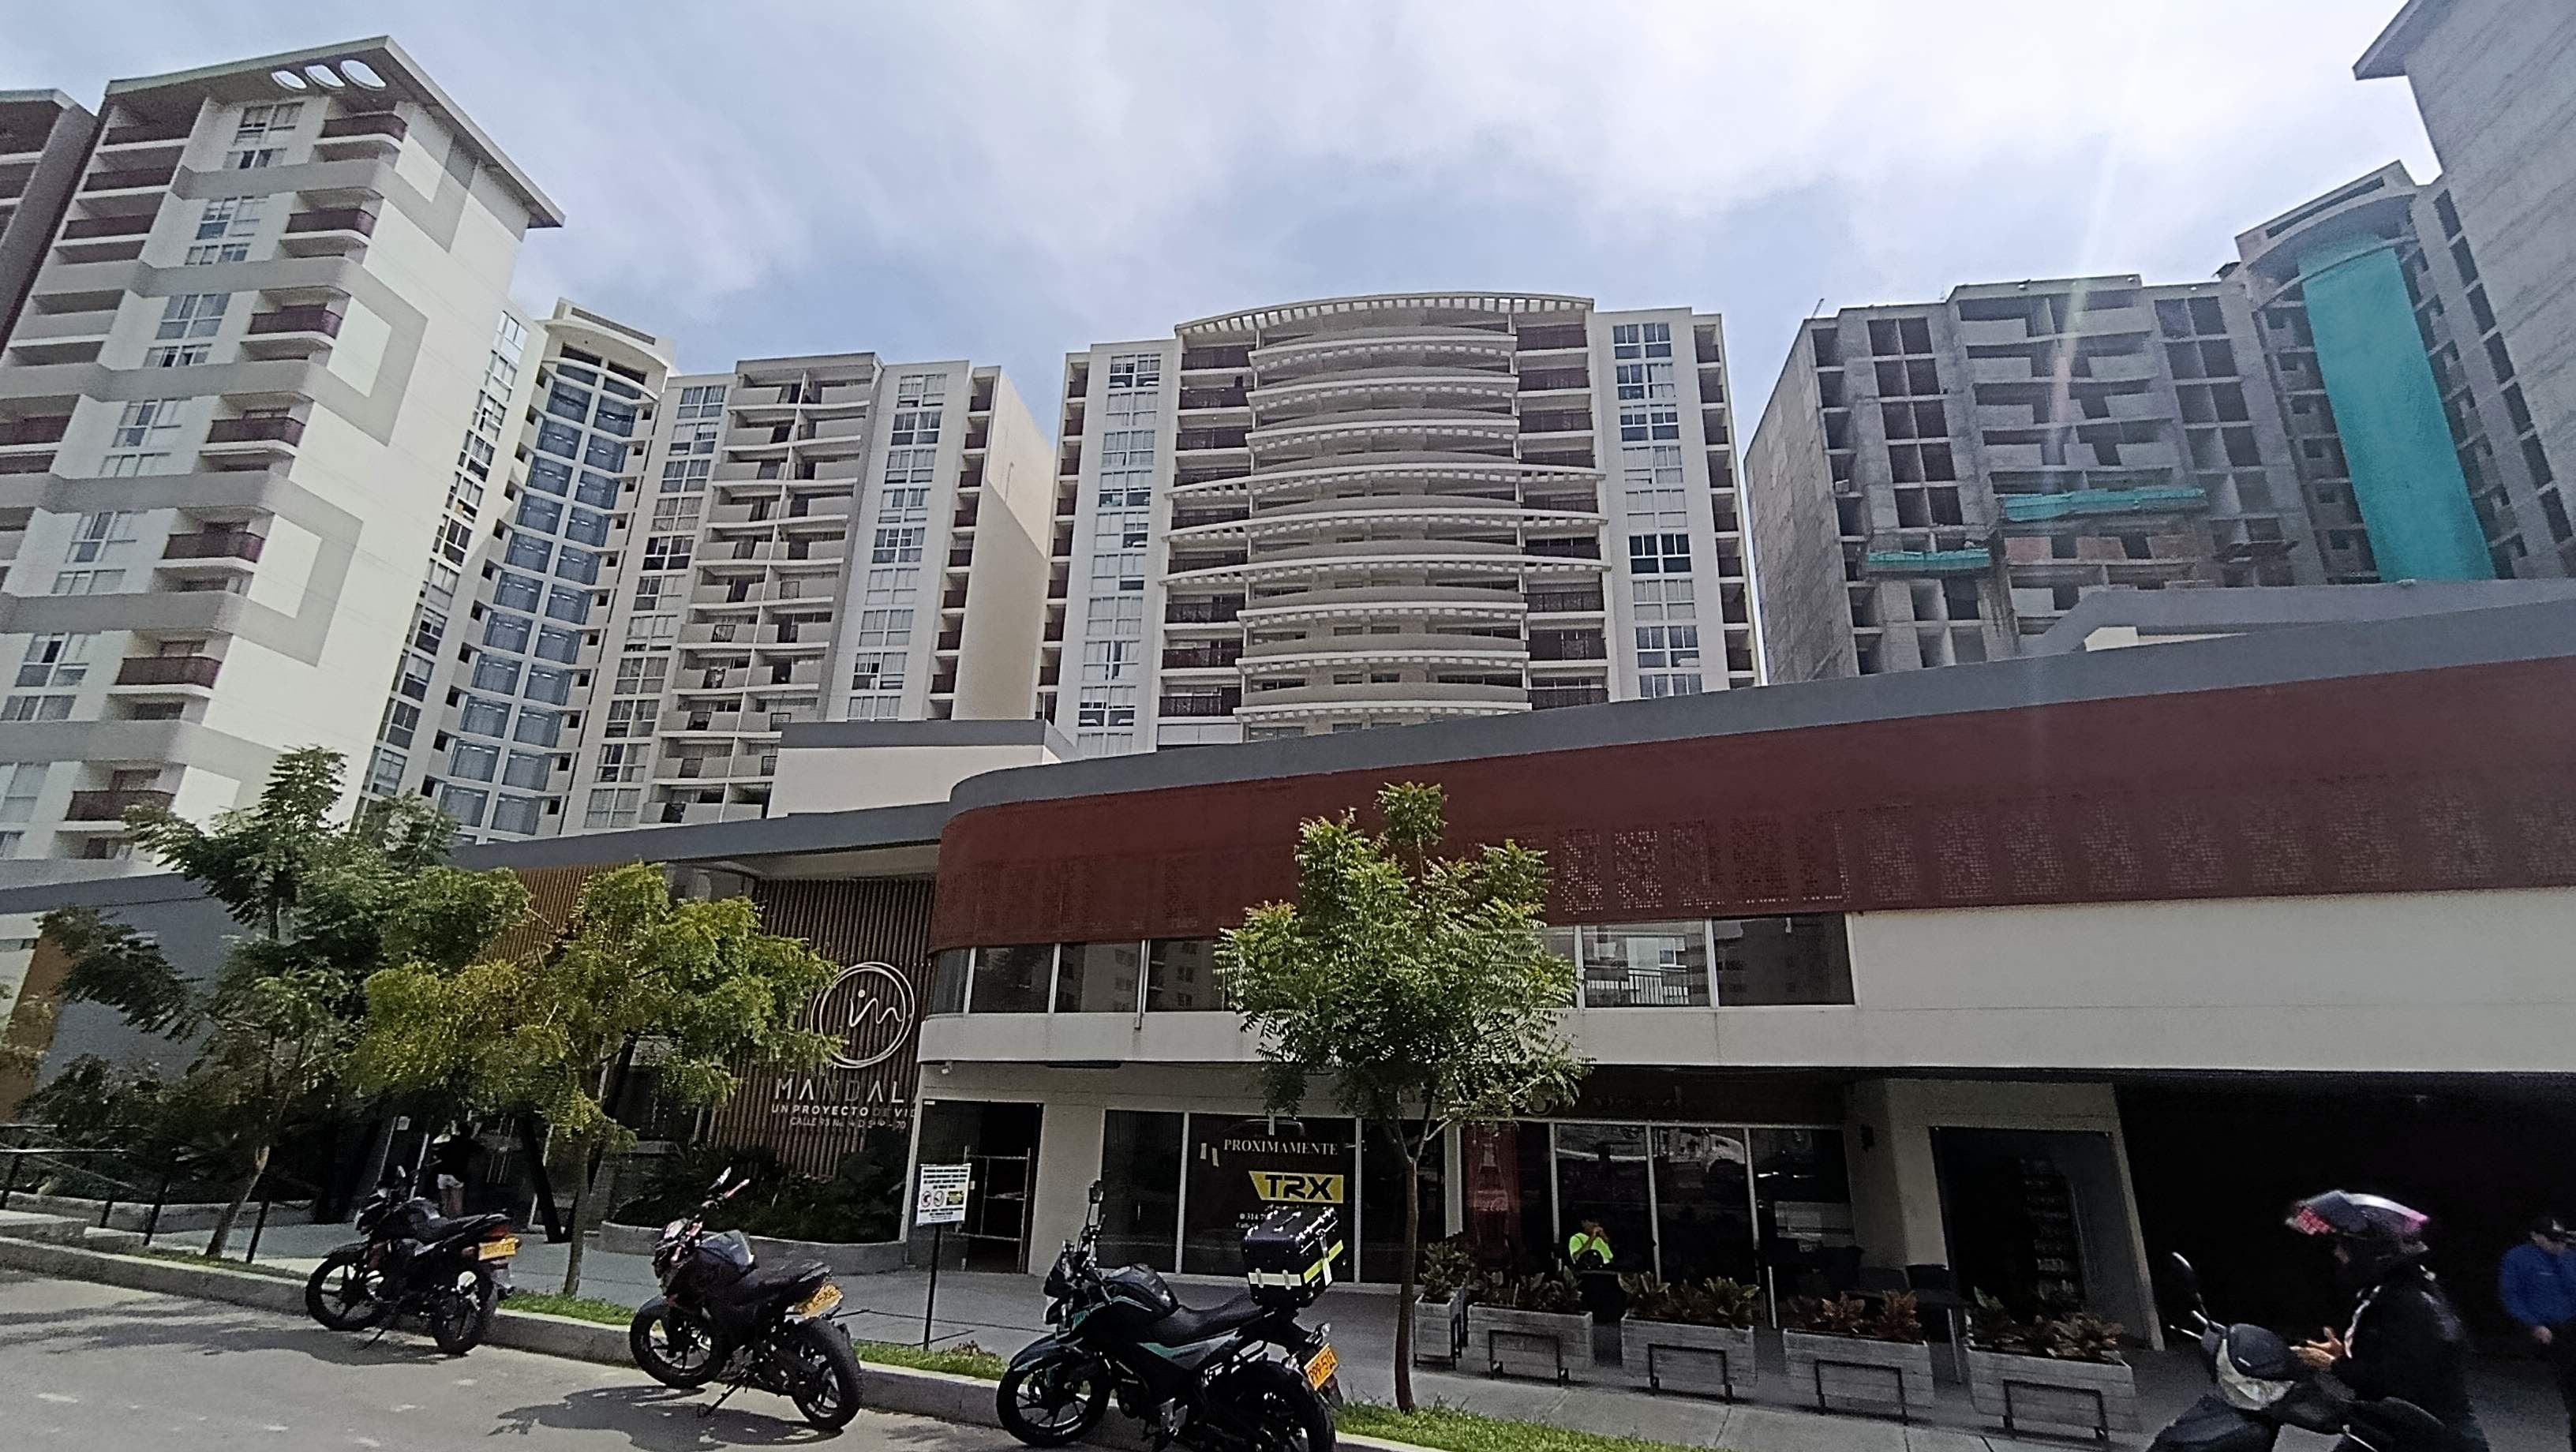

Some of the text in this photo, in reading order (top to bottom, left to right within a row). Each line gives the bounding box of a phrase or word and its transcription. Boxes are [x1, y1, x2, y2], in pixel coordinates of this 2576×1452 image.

[775, 1078, 919, 1103] MANDAL
[771, 1103, 788, 1113] UN
[792, 1105, 869, 1117] PROYECTO
[873, 1106, 892, 1117] DE
[790, 1117, 817, 1127] CALLE
[1224, 1139, 1339, 1156] PROXIMAMENTE
[1265, 1174, 1333, 1200] TRX
